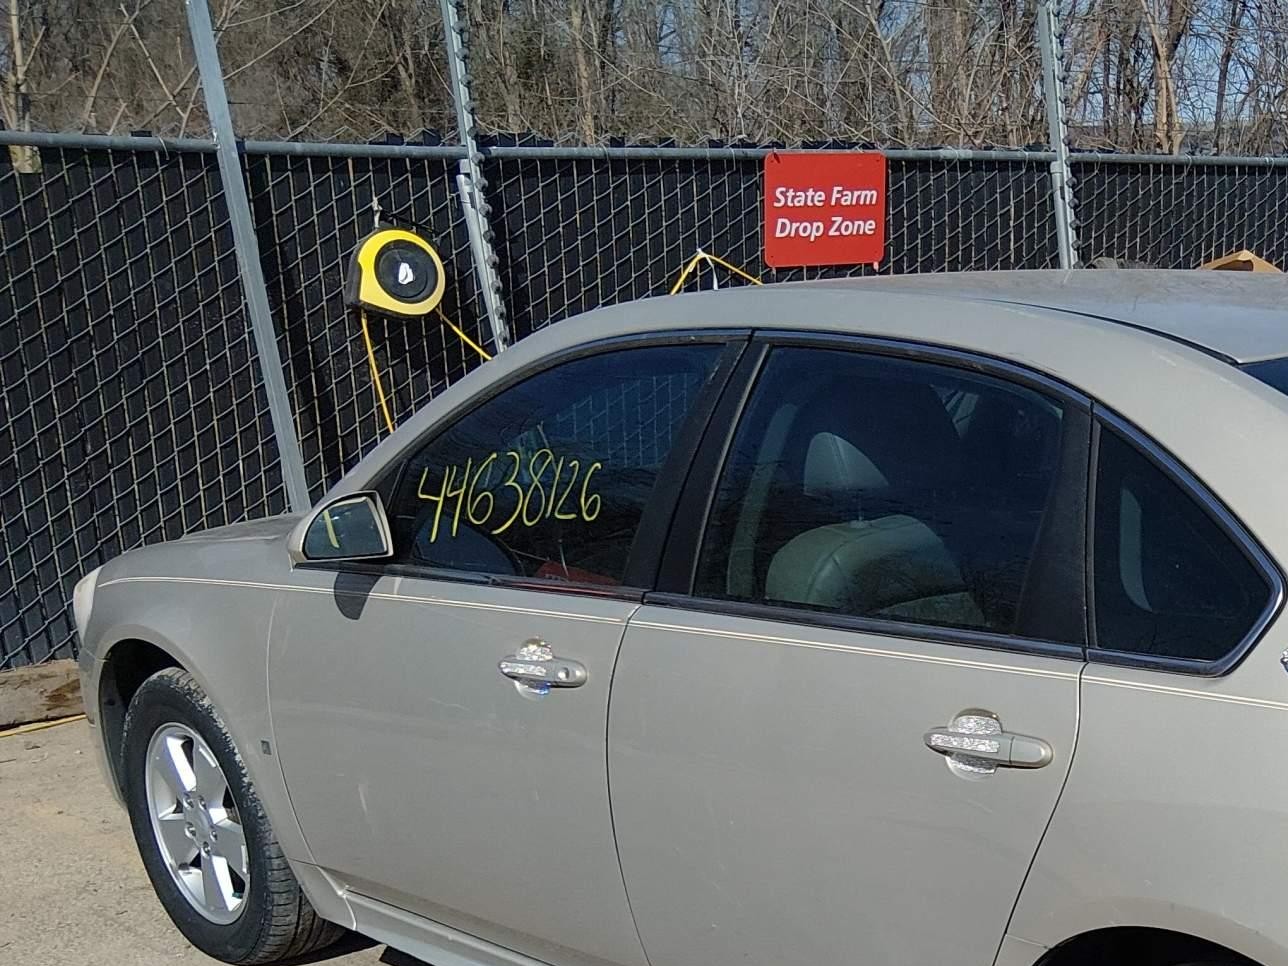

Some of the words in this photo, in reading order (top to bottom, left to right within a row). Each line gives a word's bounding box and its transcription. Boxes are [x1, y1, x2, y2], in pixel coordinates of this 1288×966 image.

[773, 187, 826, 207] State
[830, 186, 878, 206] Farm
[775, 218, 824, 241] Drop
[828, 216, 876, 236] Zone
[417, 448, 602, 544] 44638126
